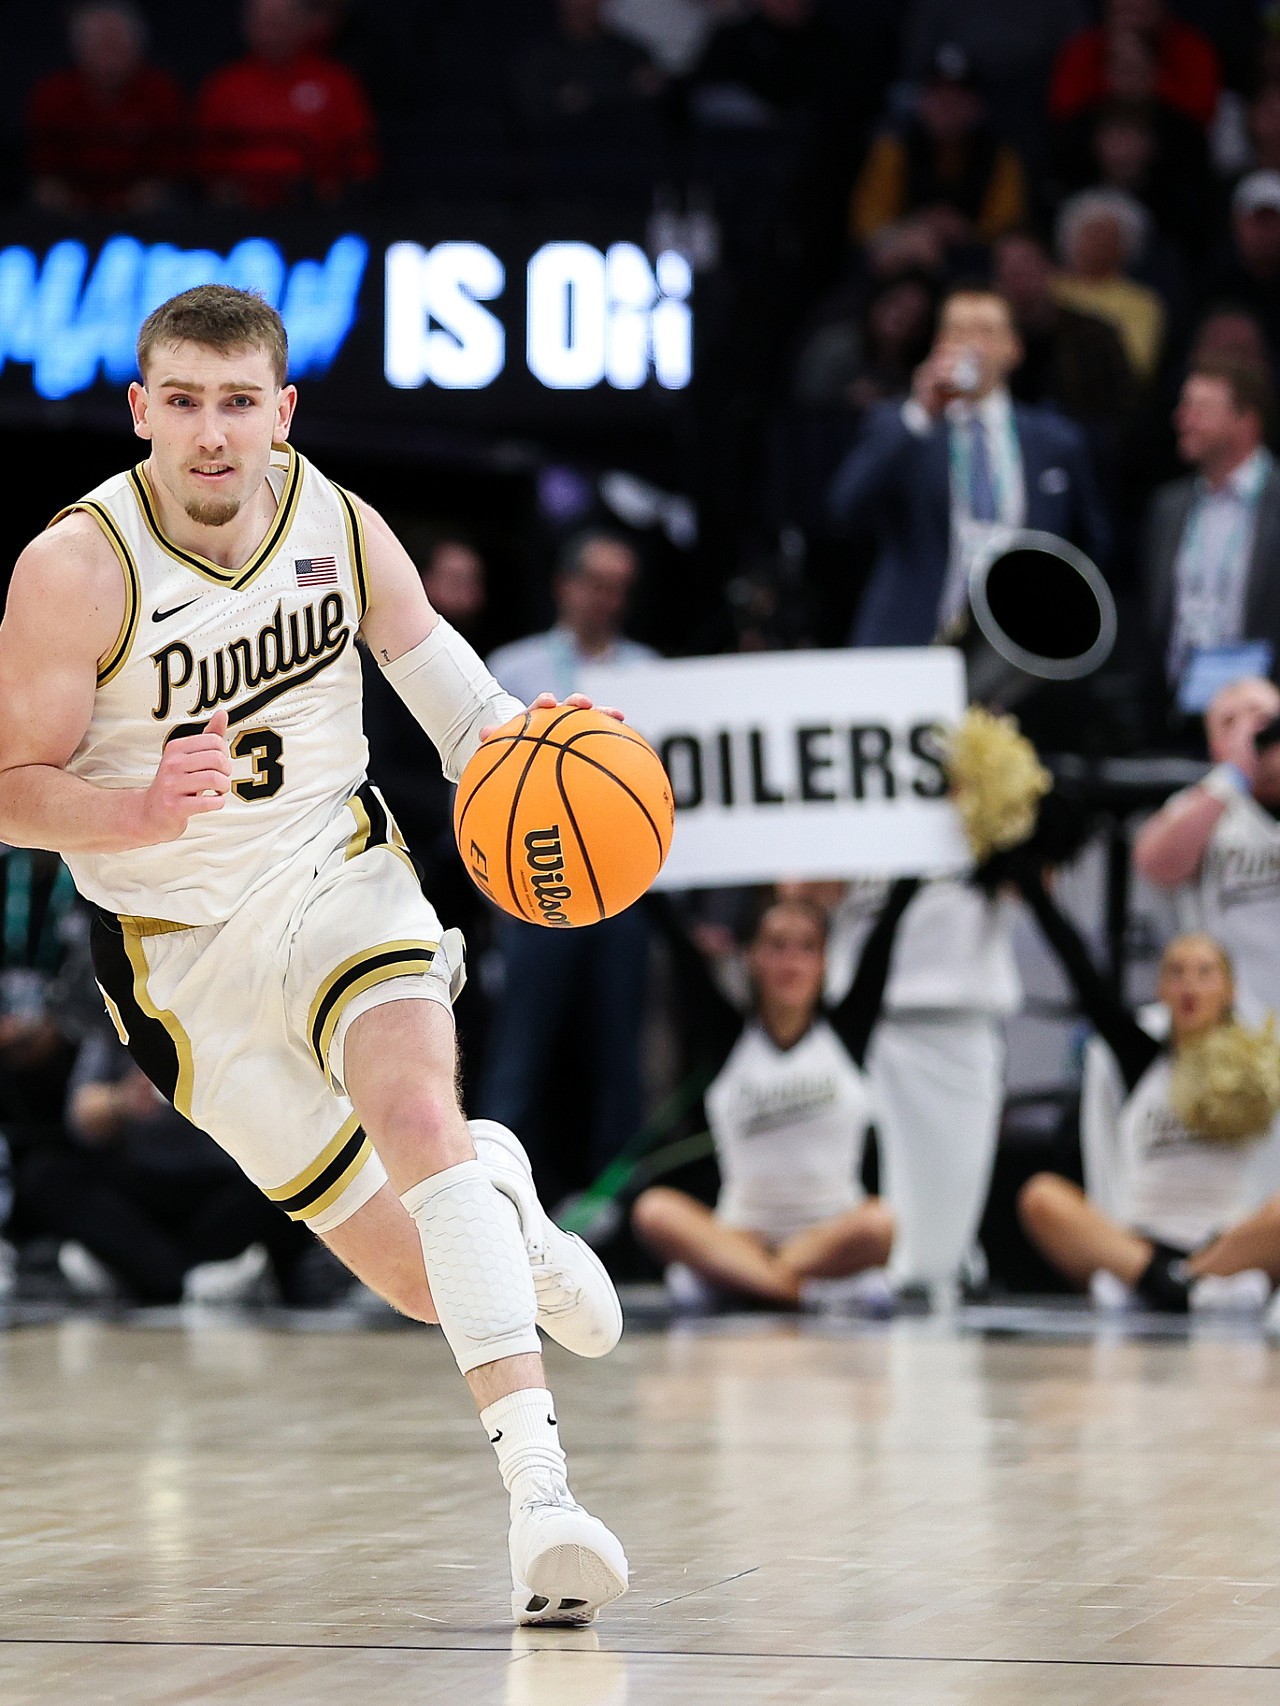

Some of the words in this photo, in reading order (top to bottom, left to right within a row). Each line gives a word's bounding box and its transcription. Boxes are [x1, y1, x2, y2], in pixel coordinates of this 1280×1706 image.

[384, 239, 506, 389] IS
[526, 239, 693, 389] ON
[149, 590, 350, 722] Purdue
[230, 726, 285, 803] 3
